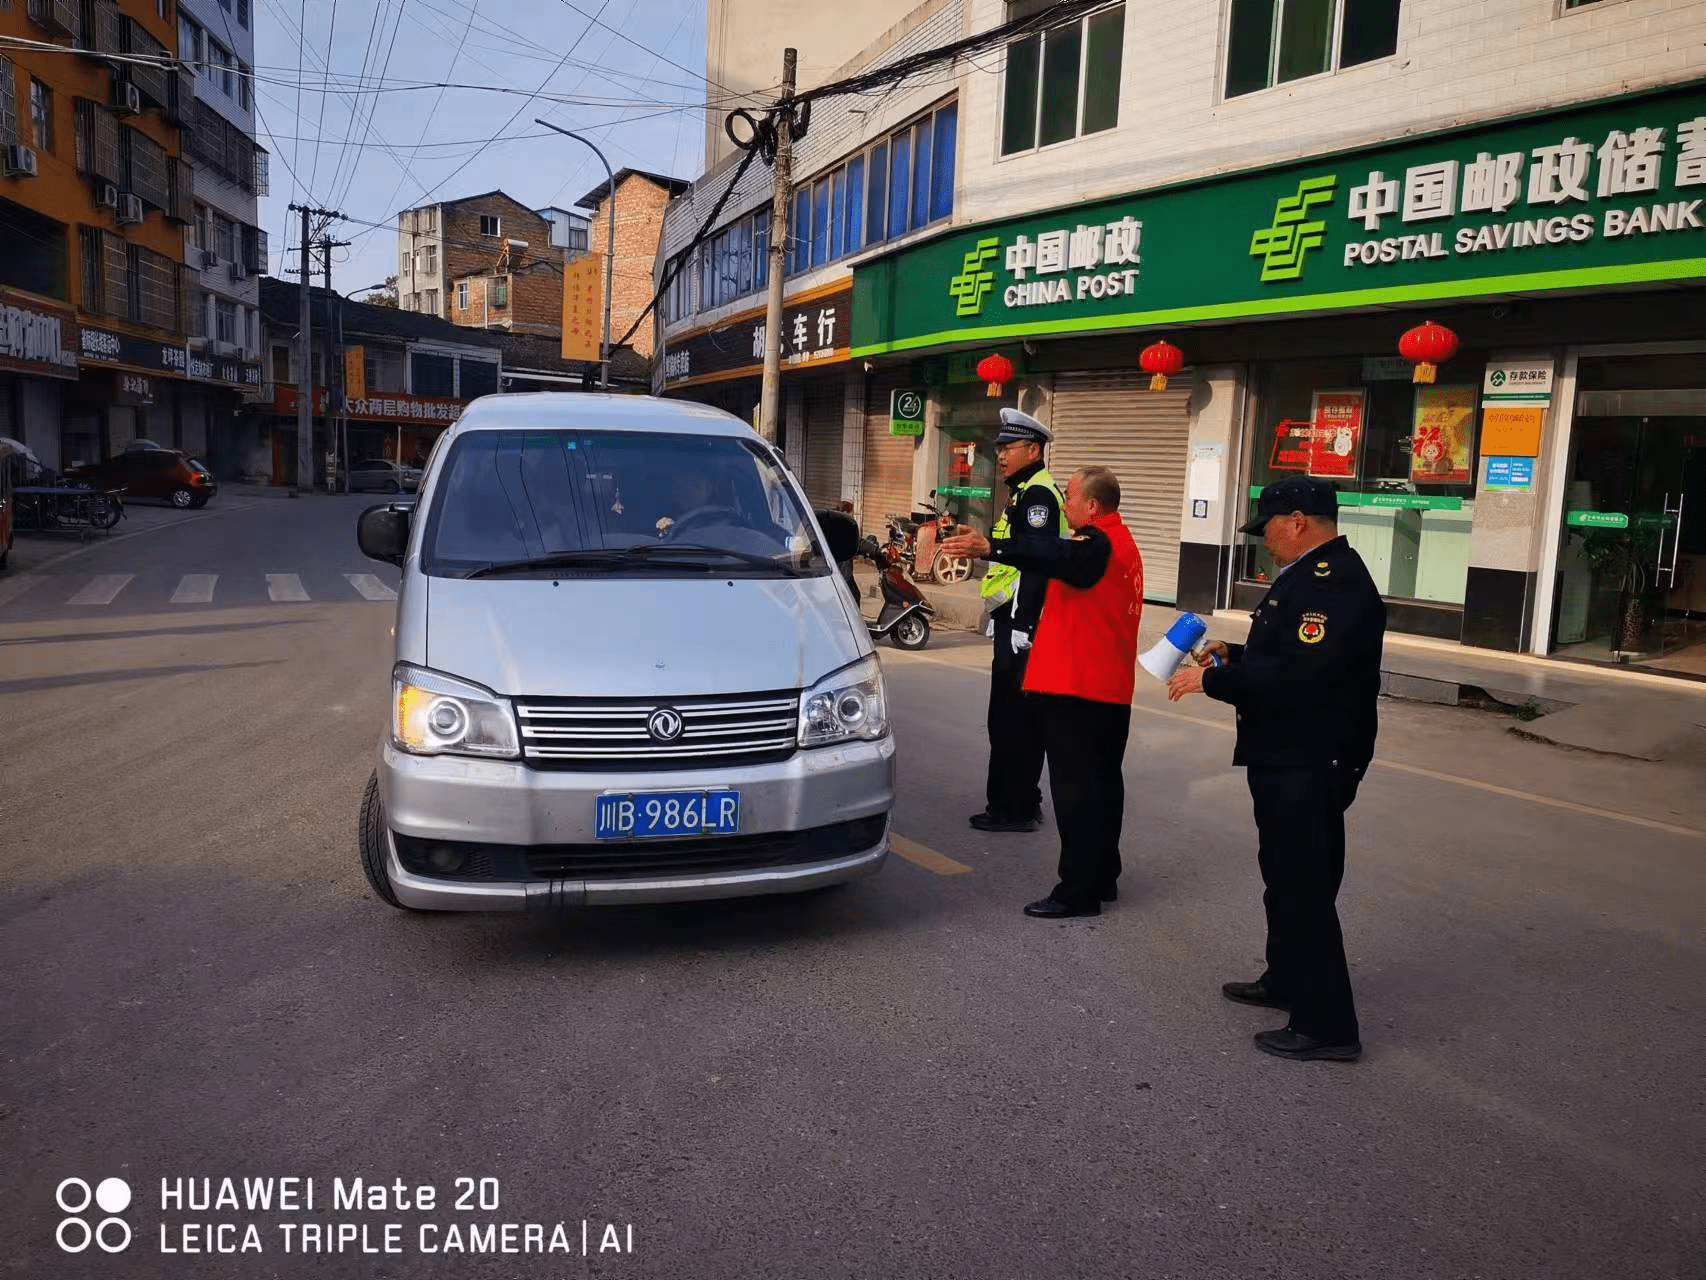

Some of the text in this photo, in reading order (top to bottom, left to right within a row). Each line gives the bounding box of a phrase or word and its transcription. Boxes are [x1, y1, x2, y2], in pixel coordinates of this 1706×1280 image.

[1005, 215, 1143, 281] 中国邮政
[1344, 199, 1704, 268] POSTAL SAVINGS BANK
[1004, 269, 1140, 308] CHINA POST
[752, 307, 837, 359] 胡车行
[1509, 369, 1548, 381] 存款保险
[340, 397, 467, 421] 大众两层购物批发超
